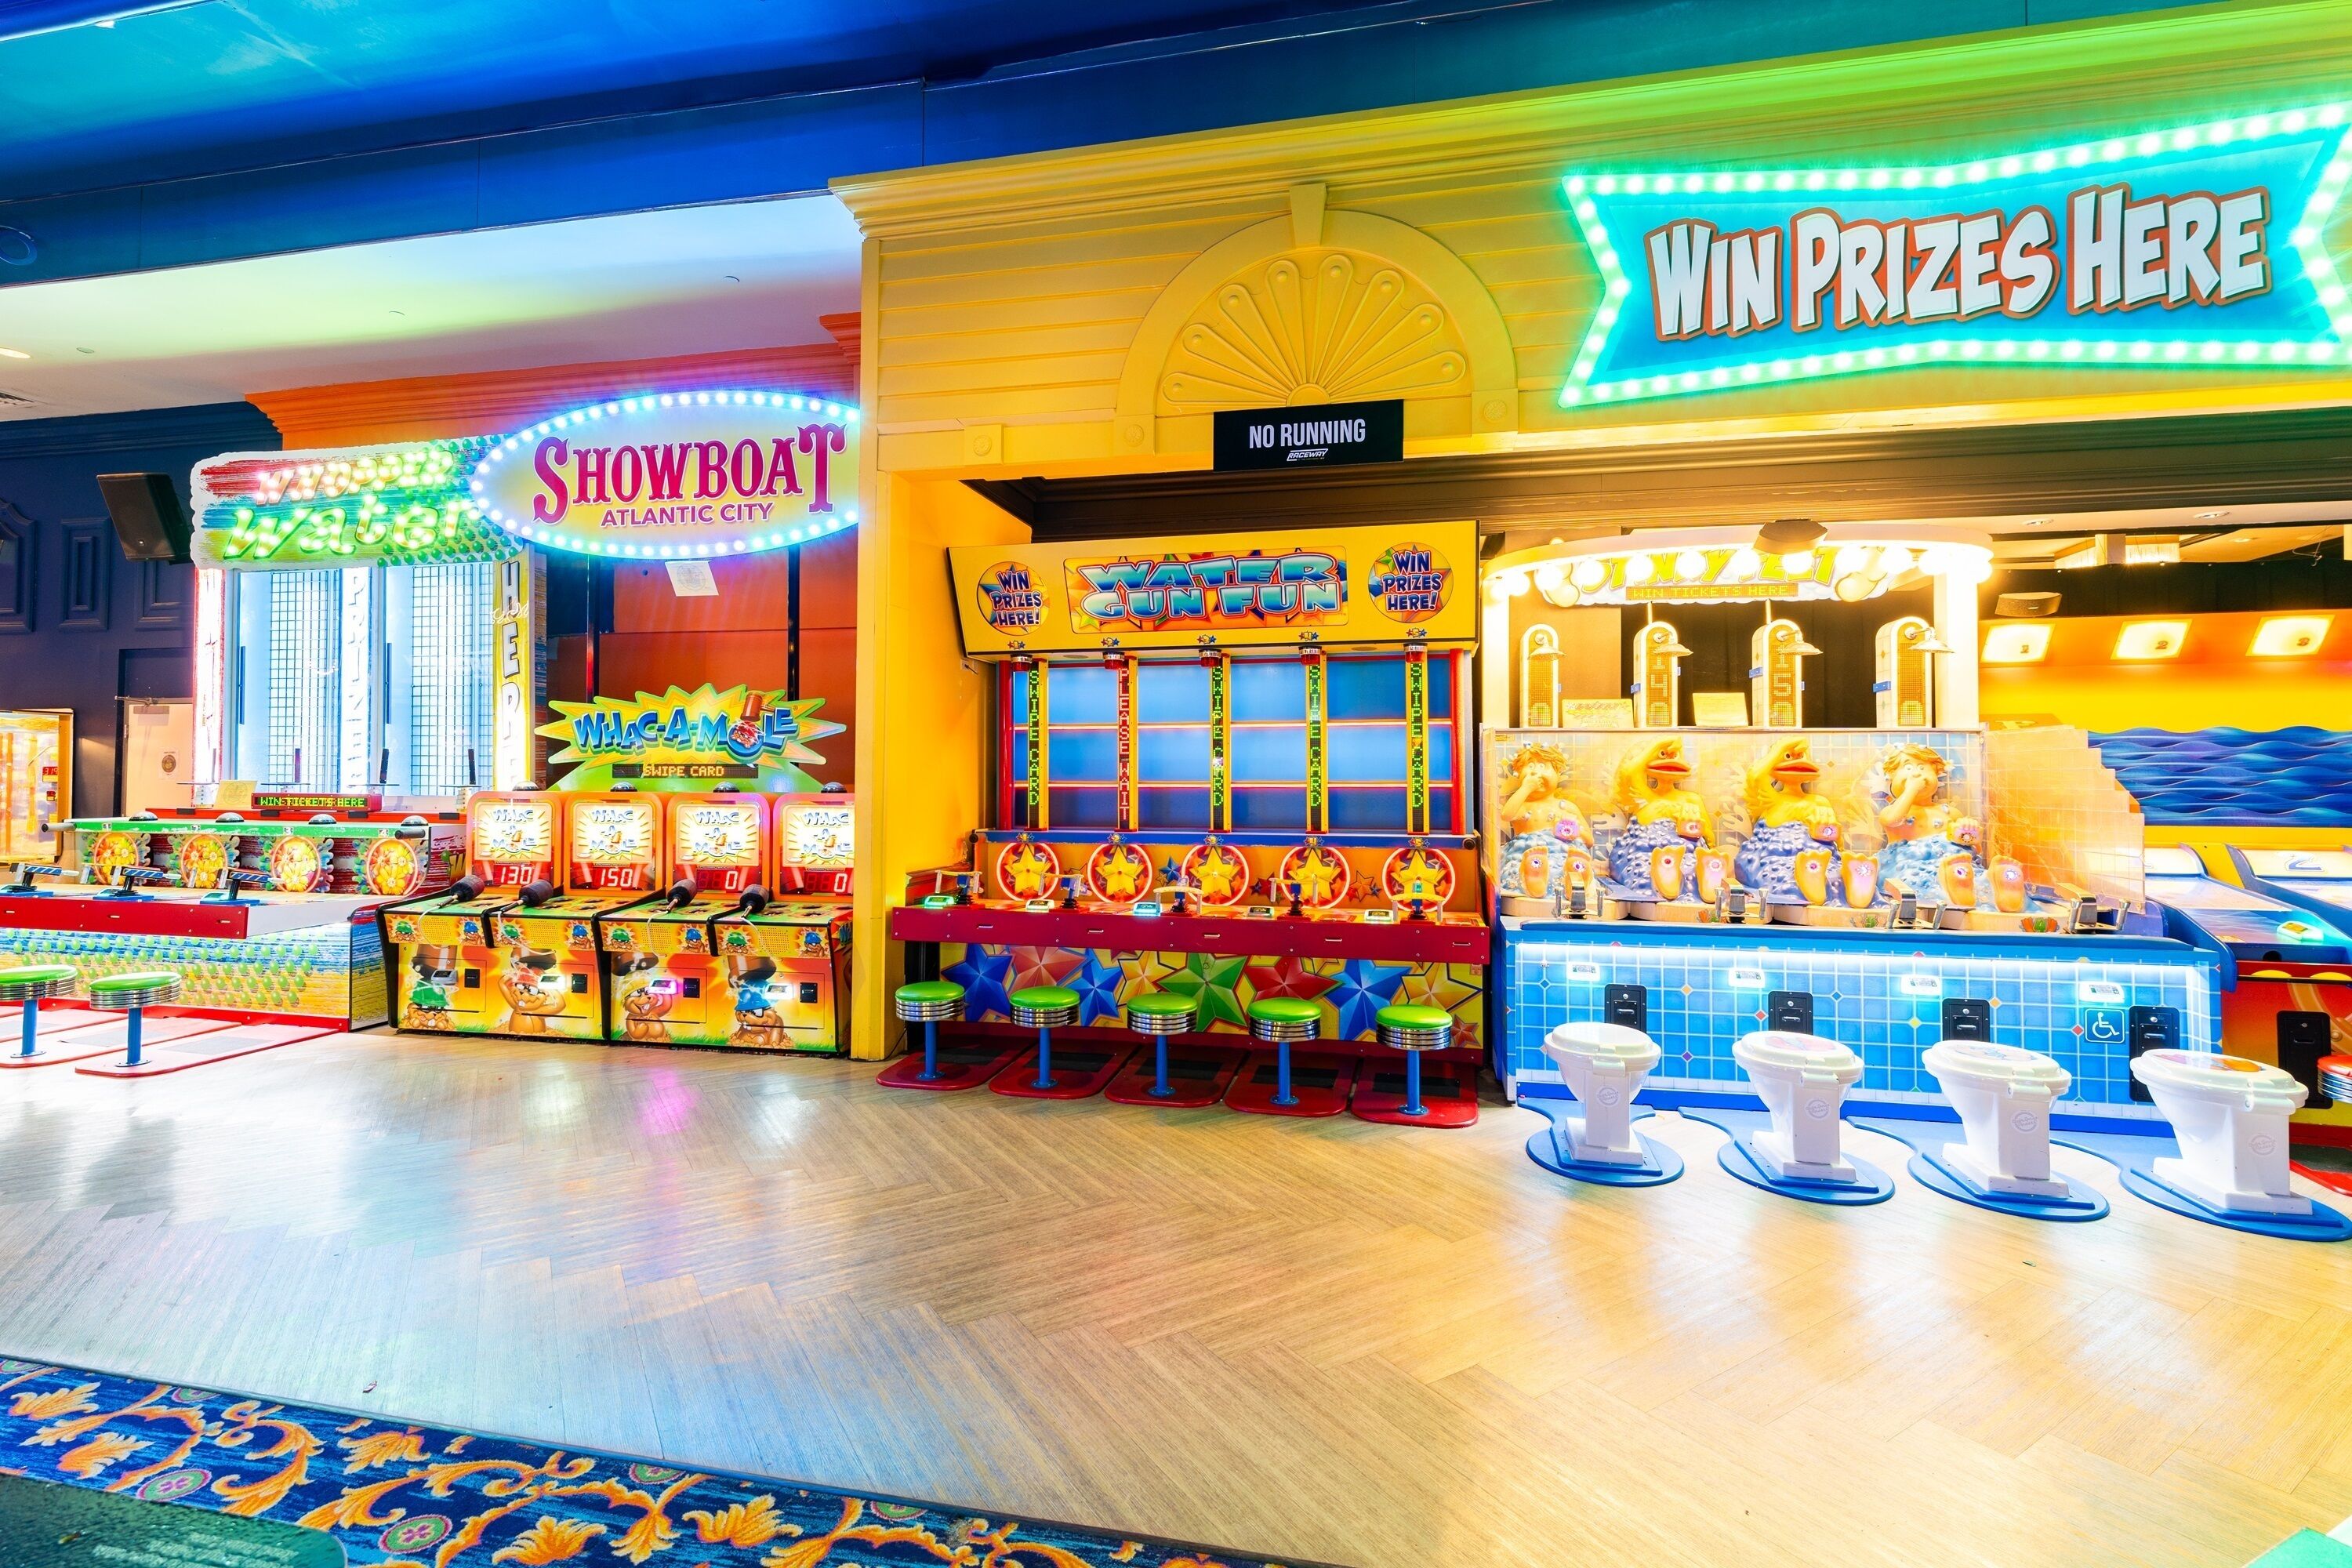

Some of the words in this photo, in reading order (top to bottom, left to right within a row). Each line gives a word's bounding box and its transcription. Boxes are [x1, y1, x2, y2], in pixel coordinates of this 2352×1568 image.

[1648, 220, 1783, 340] WIN
[1794, 205, 2058, 329] PRIZES
[2070, 185, 2269, 311] HERE
[1249, 424, 1274, 448] NO
[1280, 419, 1366, 447] RUNNING
[1287, 450, 1327, 460] RACEWAY
[255, 450, 454, 505] WHOPPER
[532, 423, 848, 524] SHOWBOAT
[601, 505, 714, 528] ATLANTIC
[720, 502, 774, 522] CITY
[1077, 554, 1337, 592] WATER
[1393, 551, 1431, 574] WIN
[1582, 549, 1737, 593] STNY
[998, 570, 1030, 591] WIN
[1382, 573, 1442, 593] PRIZES
[1632, 589, 1664, 597] WIN
[1671, 586, 1742, 597] TICKETS
[1748, 585, 1789, 595] HERE
[989, 590, 1043, 610] PRIZES
[1082, 587, 1205, 619] GUN
[1218, 582, 1339, 615] FUN
[1387, 590, 1437, 612] HERE!
[996, 608, 1040, 627] HERE!
[2020, 644, 2029, 654] 1
[2155, 641, 2169, 650] 2
[2297, 637, 2310, 647] 3
[1029, 670, 1039, 741] SWIPE
[1119, 668, 1130, 754] PLEASE
[1213, 666, 1223, 739] SWIPE
[1411, 662, 1422, 738] SWIPE
[572, 706, 800, 757] WHAC-A-MOLE
[643, 764, 685, 777] SWIPE
[690, 764, 724, 777] CARD
[1029, 748, 1039, 805] CARD
[1310, 746, 1321, 807] CARD
[1412, 746, 1423, 808] CARD
[1120, 762, 1130, 820] WAIT
[501, 866, 532, 885] 130
[601, 868, 633, 887] 150
